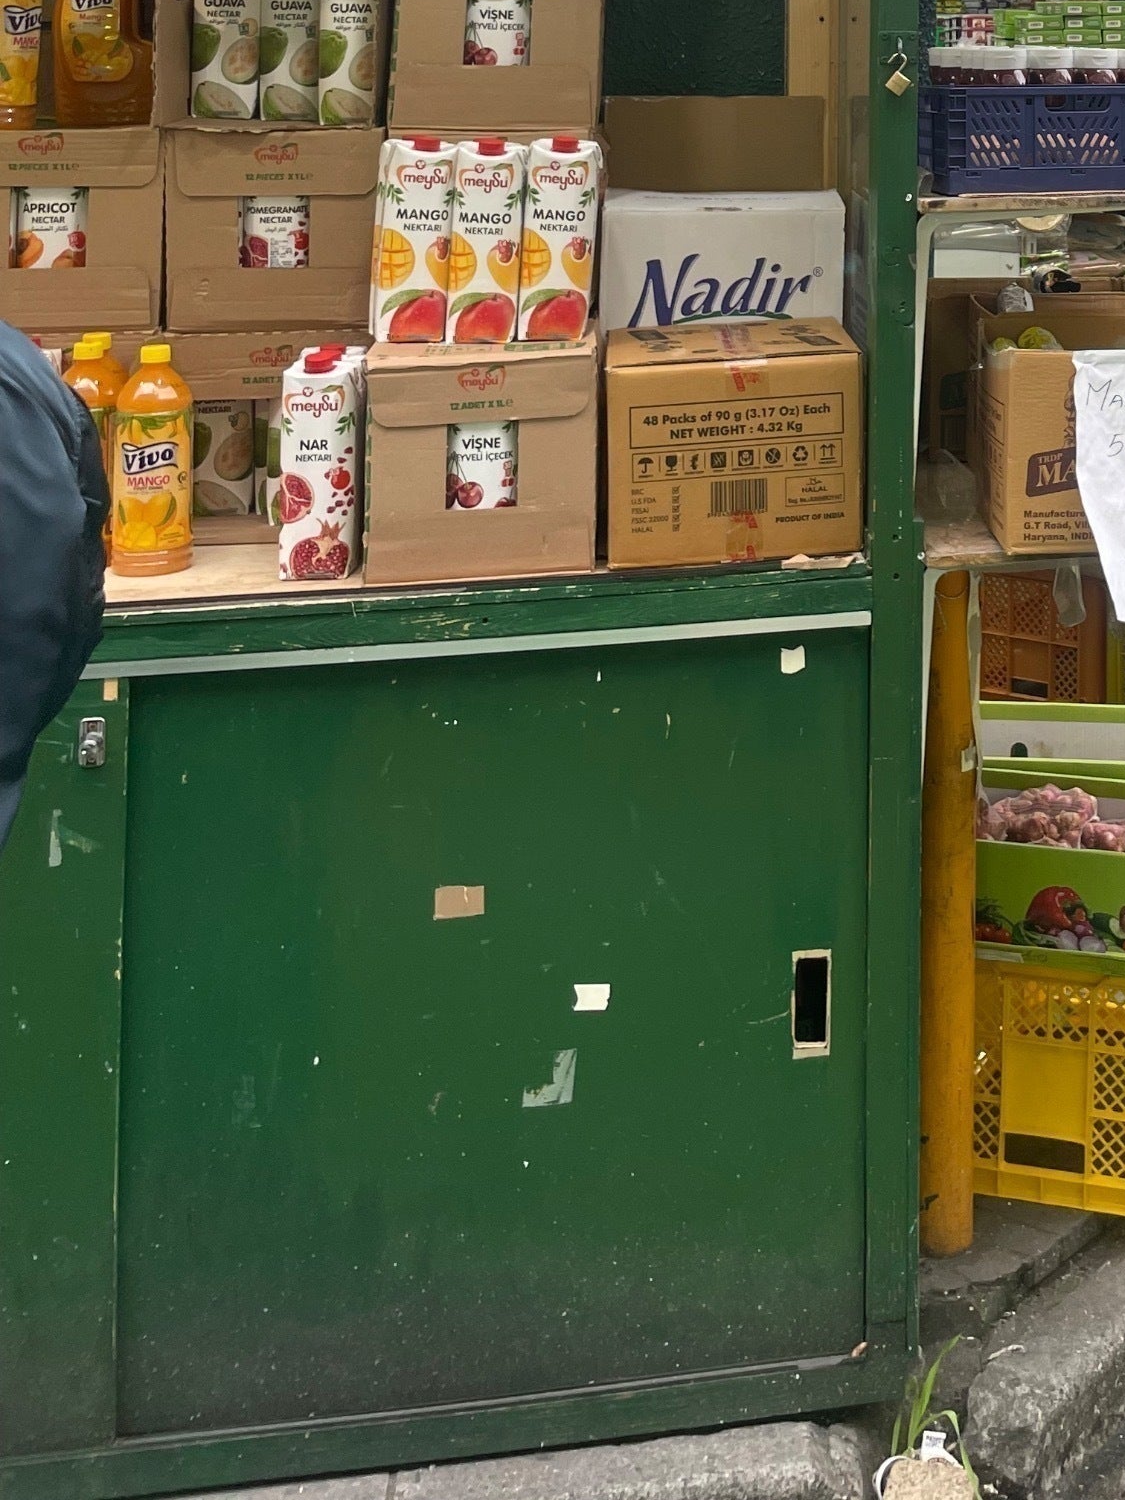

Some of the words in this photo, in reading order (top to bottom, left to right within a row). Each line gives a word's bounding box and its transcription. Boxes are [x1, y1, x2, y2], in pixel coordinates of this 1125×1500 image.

[270, 0, 312, 11] GUAVA
[330, 3, 373, 14] GUAVA
[206, 10, 241, 18] NECTAR
[273, 13, 308, 21] NECTAR
[479, 6, 514, 21] VİŞNE
[333, 16, 368, 24] NECTAR
[13, 36, 40, 46] MANG
[23, 202, 77, 214] APRICOT
[32, 216, 65, 224] NECTAR
[259, 216, 293, 224] NECTAR
[396, 208, 449, 221] MANGO
[458, 212, 512, 224] MANGO
[532, 208, 586, 221] MANGO
[403, 223, 442, 232] NEKTARI
[464, 227, 503, 235] NEKTARI
[539, 223, 578, 232] NEKTARI
[628, 253, 812, 328] Nadir
[643, 415, 659, 426] 48
[662, 412, 697, 424] Packs
[700, 411, 712, 422] of
[715, 411, 730, 421] 90
[734, 411, 742, 422] g
[745, 407, 775, 420] (3.17
[779, 405, 800, 418] Oz)
[803, 403, 831, 414] Each
[669, 428, 694, 440] NET
[697, 425, 746, 438] WEIGHT
[757, 422, 783, 434] 4.32
[787, 421, 803, 433] Kg
[299, 439, 329, 451] NAR
[462, 434, 502, 452] VİŞNE
[1107, 433, 1124, 457] 5
[124, 446, 174, 472] Vivo
[295, 453, 332, 463] NEKTARI
[485, 450, 514, 462] İÇECEK
[1036, 460, 1076, 487] MA
[127, 474, 171, 488] MANGO
[775, 514, 810, 523] PRODUCT
[1023, 510, 1086, 518] Manufacture
[1044, 521, 1072, 531] Road,
[1023, 533, 1067, 542] Haryana,
[1071, 532, 1094, 540] INDI
